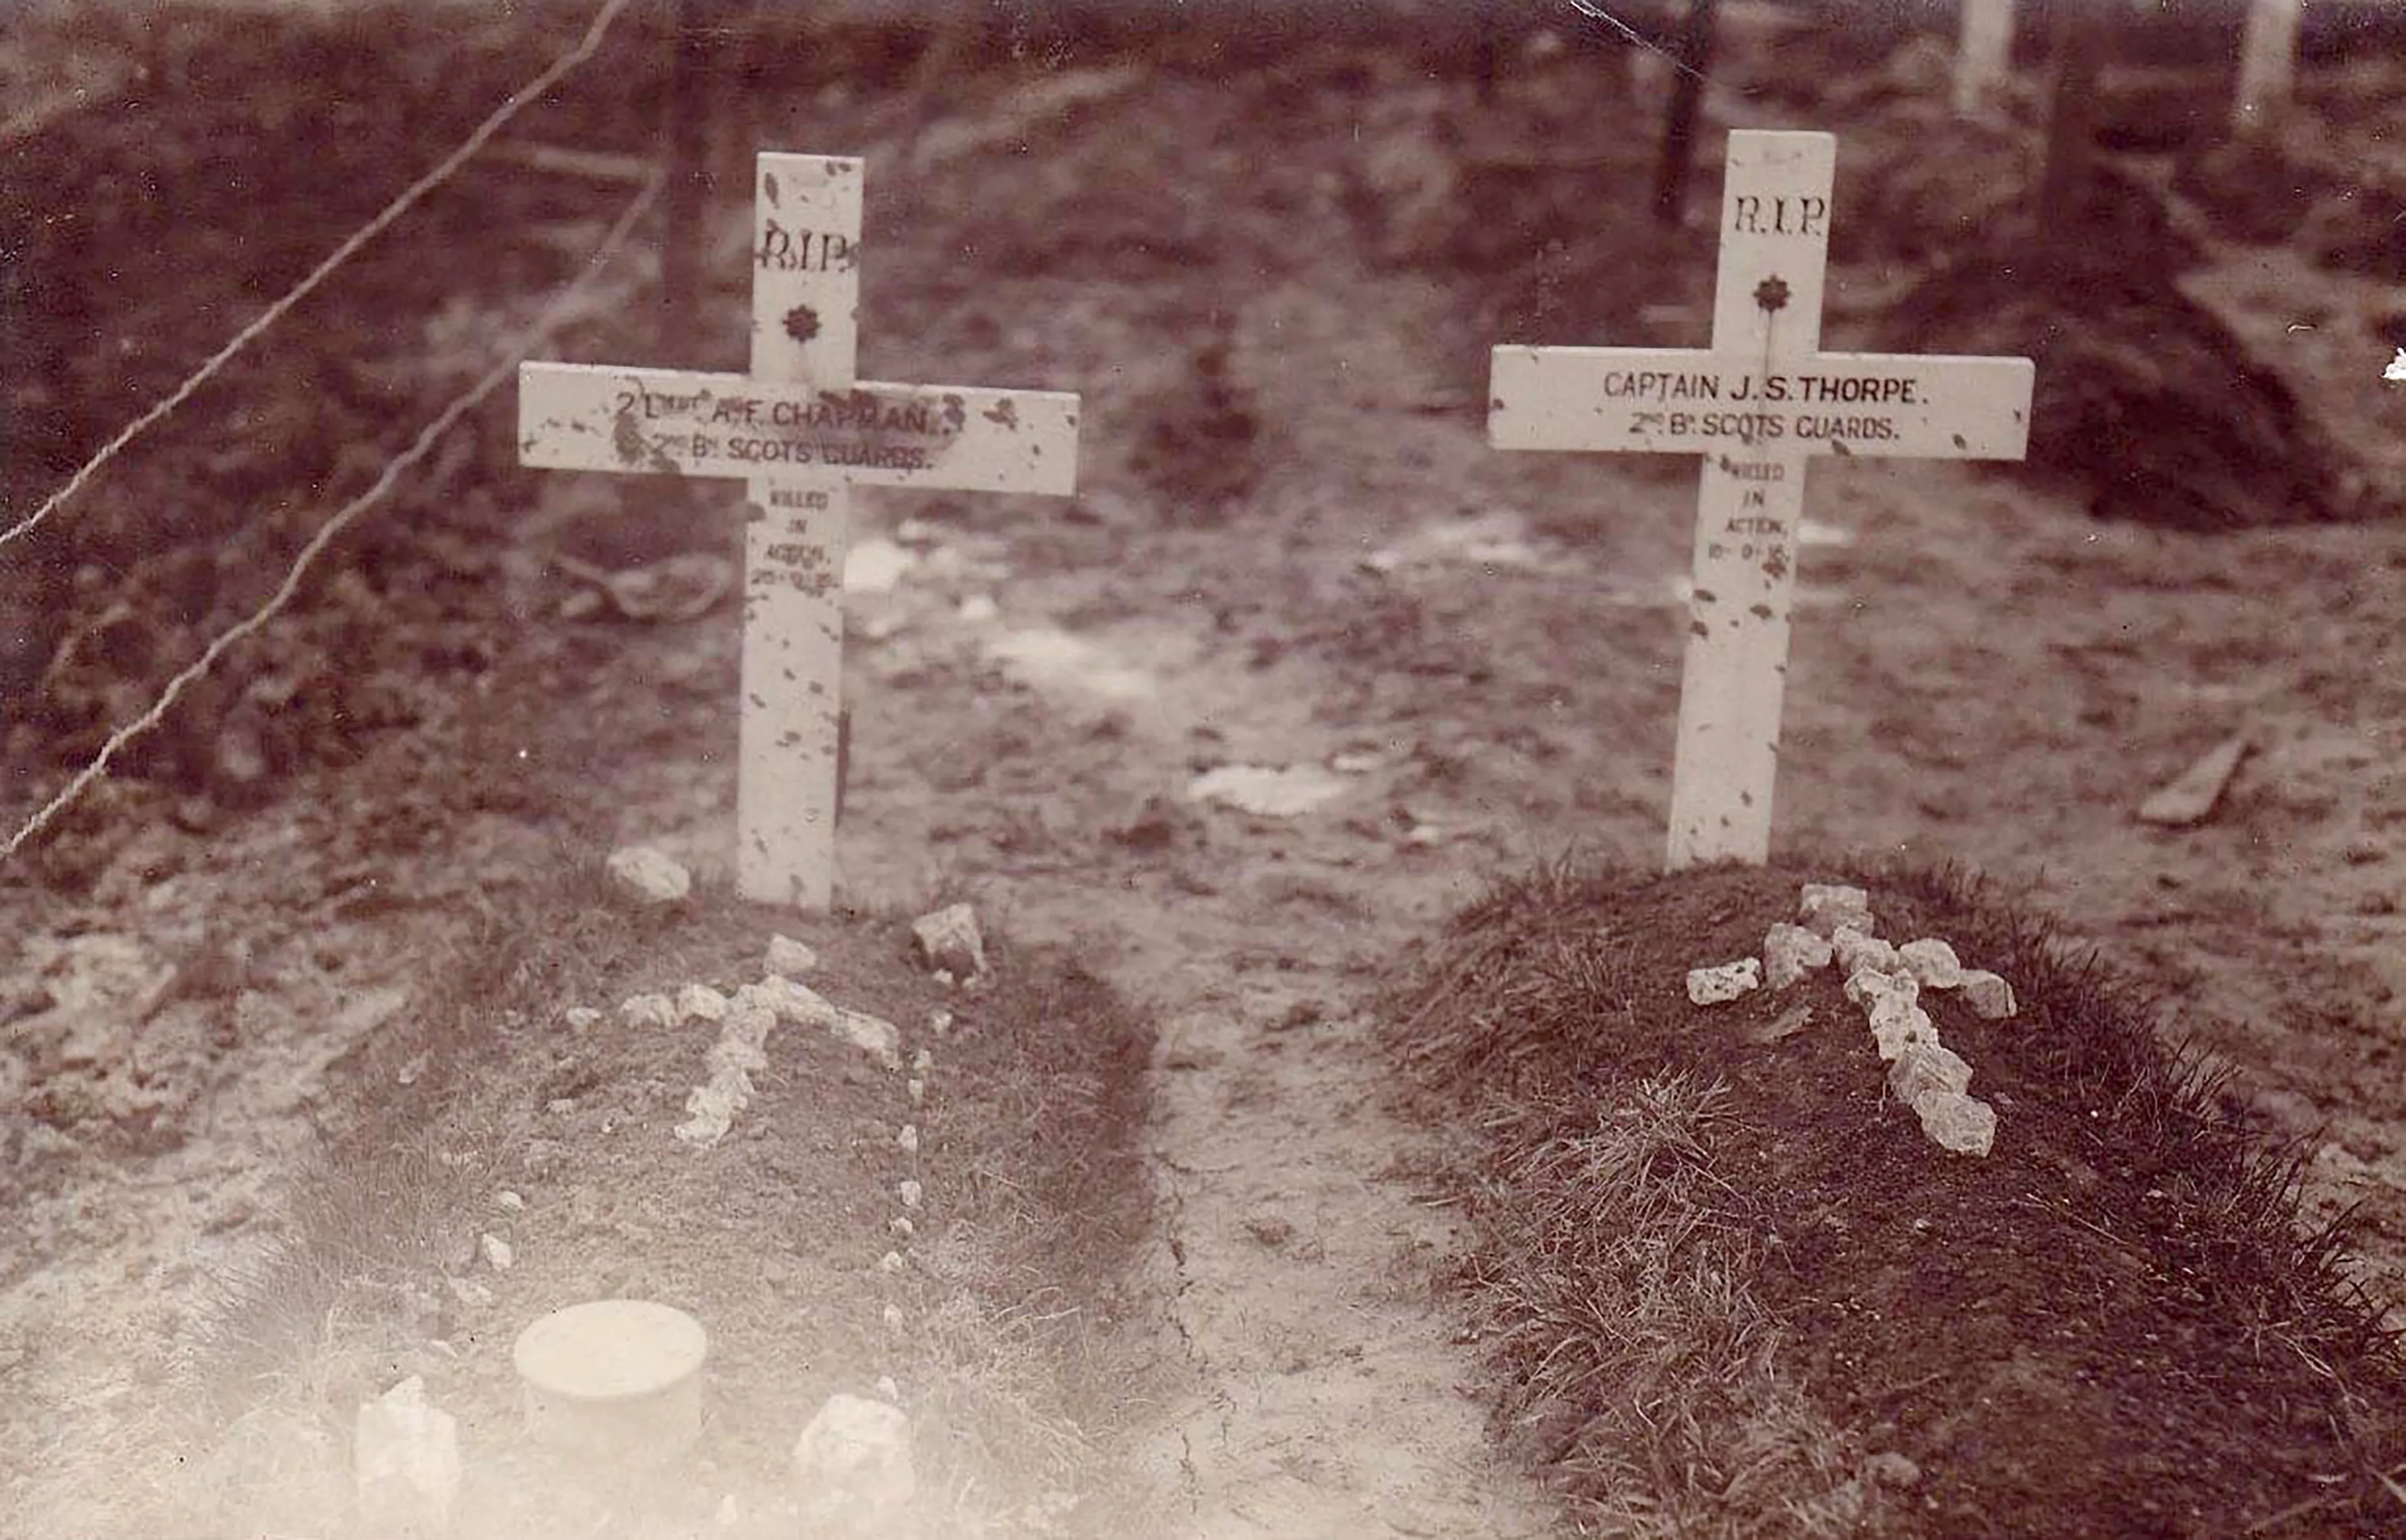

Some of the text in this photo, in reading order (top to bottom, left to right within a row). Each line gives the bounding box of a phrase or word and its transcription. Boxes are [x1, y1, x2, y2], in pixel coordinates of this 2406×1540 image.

[1604, 372, 1719, 401] CAPTAIN
[1703, 413, 1784, 439] SCOTS
[1796, 416, 1899, 440] GUARDS.
[729, 438, 812, 463] SCOTS
[1744, 489, 1765, 507] IN
